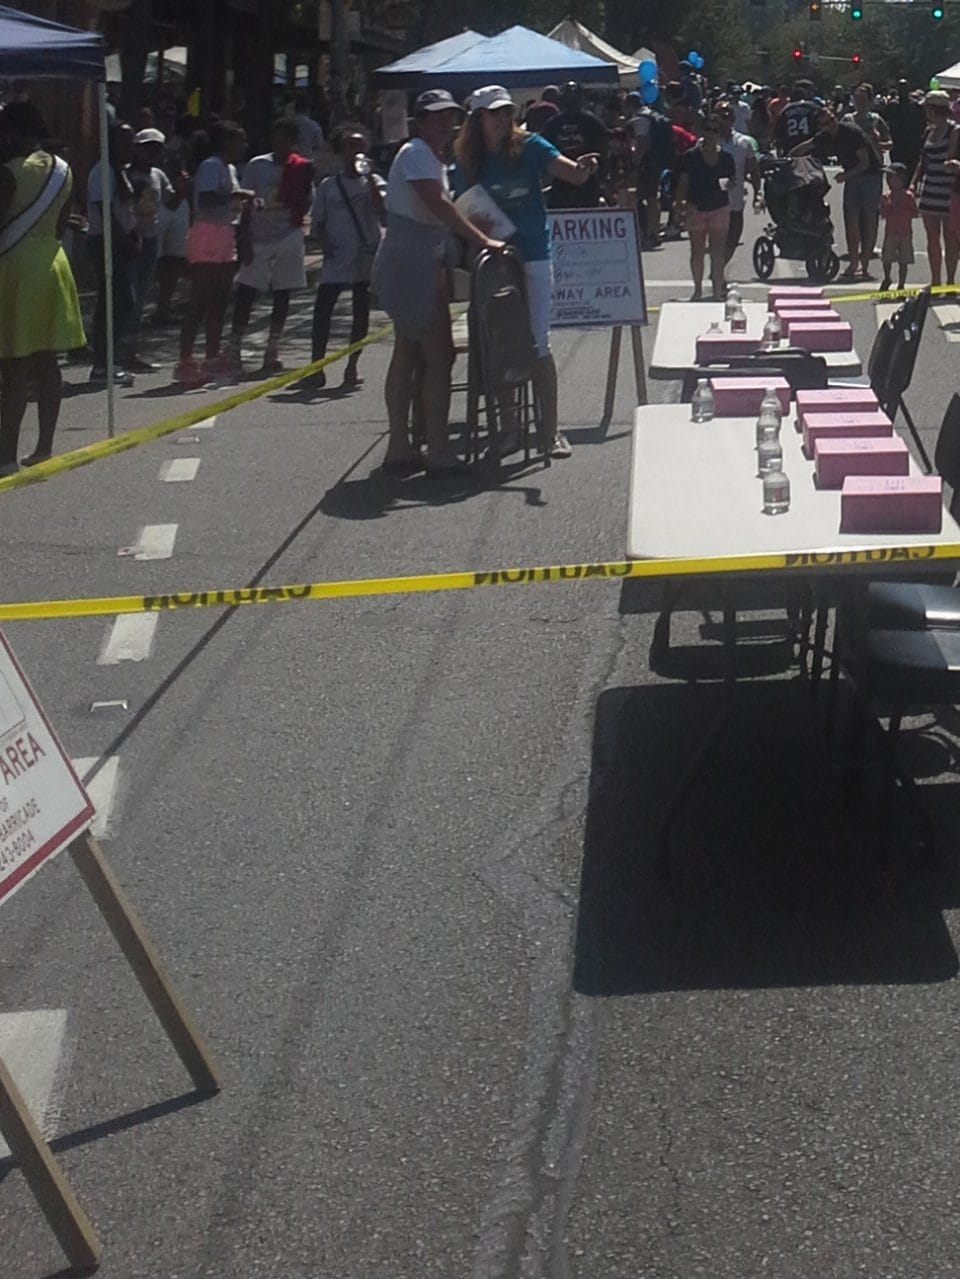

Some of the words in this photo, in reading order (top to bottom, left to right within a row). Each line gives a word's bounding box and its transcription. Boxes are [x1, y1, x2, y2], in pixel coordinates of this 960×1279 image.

[787, 117, 809, 136] 24
[551, 218, 627, 240] ARKING
[595, 285, 632, 298] AREA
[0, 732, 46, 786] AREA
